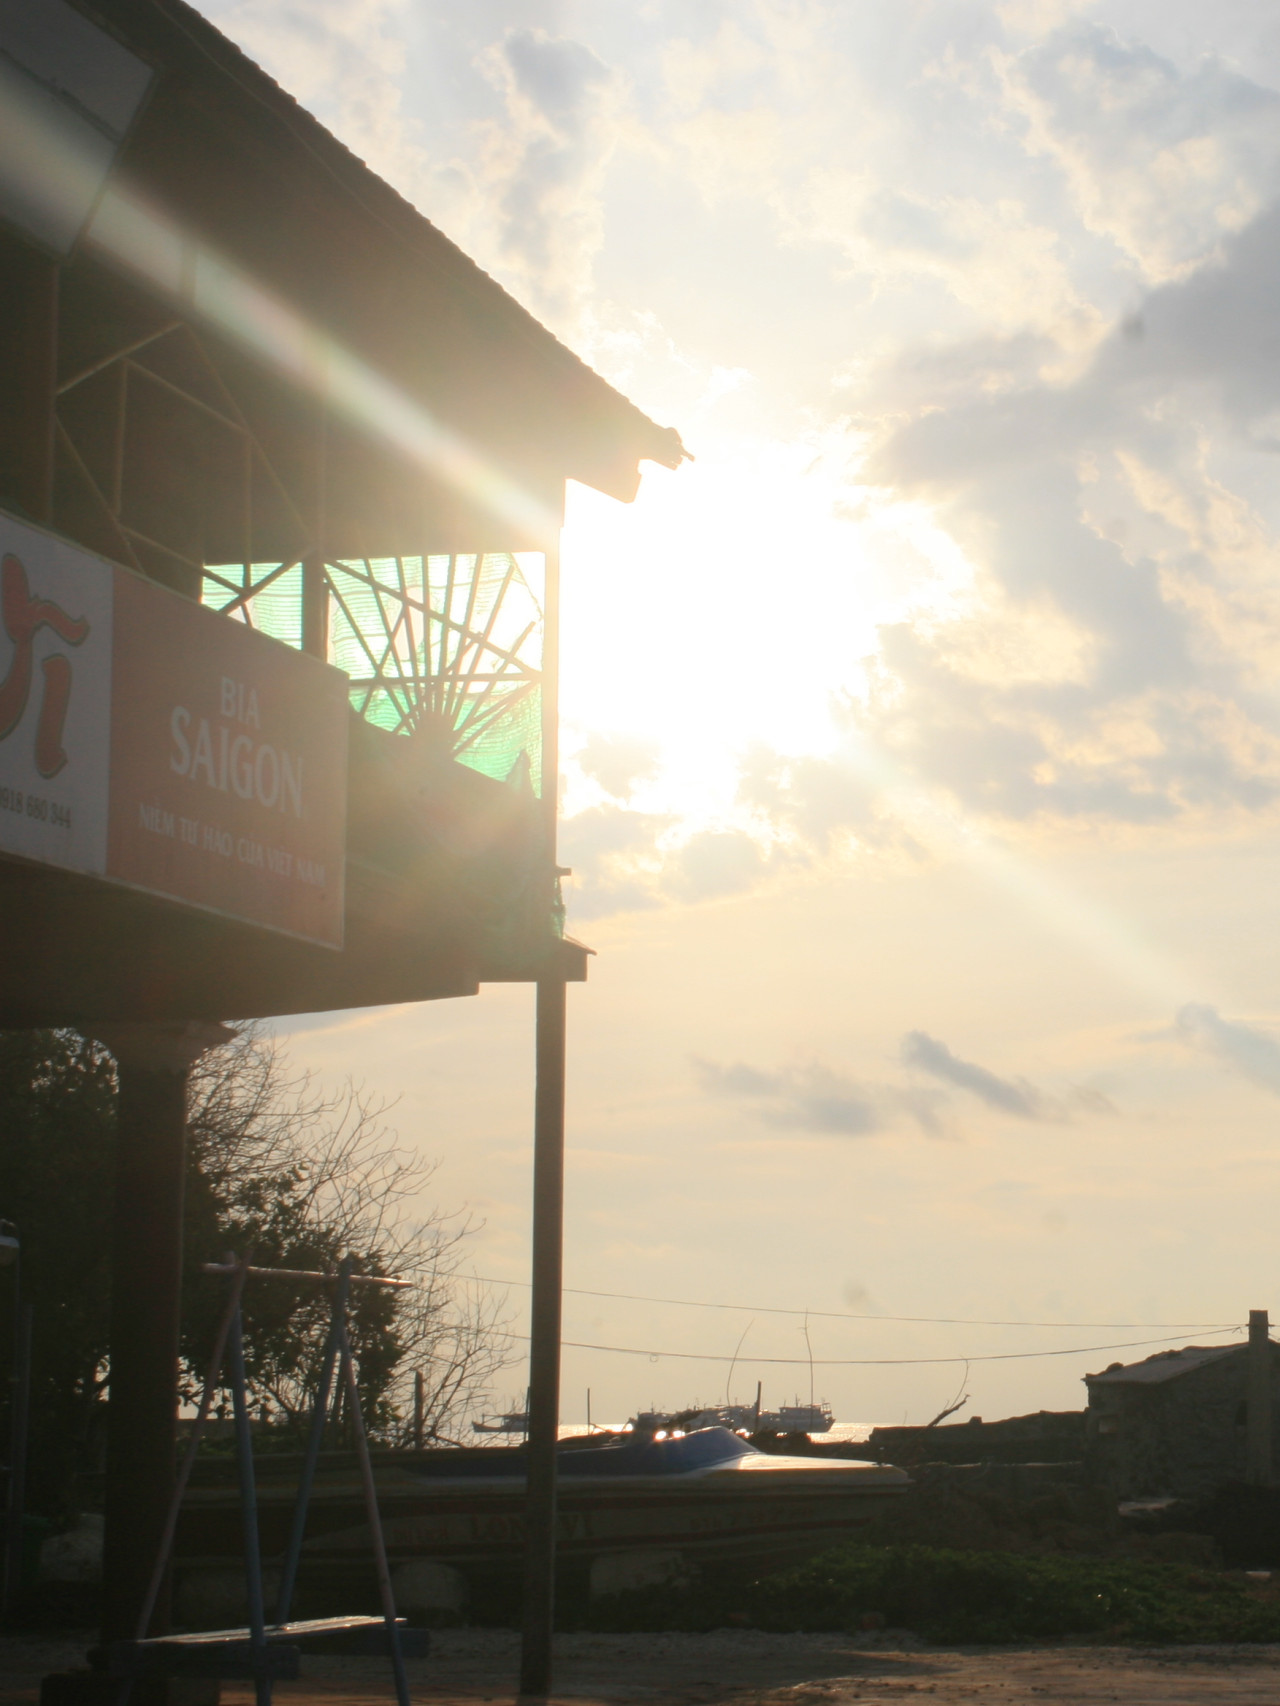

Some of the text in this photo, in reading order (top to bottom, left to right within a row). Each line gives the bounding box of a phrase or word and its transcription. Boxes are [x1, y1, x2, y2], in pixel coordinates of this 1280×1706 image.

[220, 675, 261, 729] BIA
[170, 704, 303, 819] SAIGON
[296, 857, 326, 888] NAM
